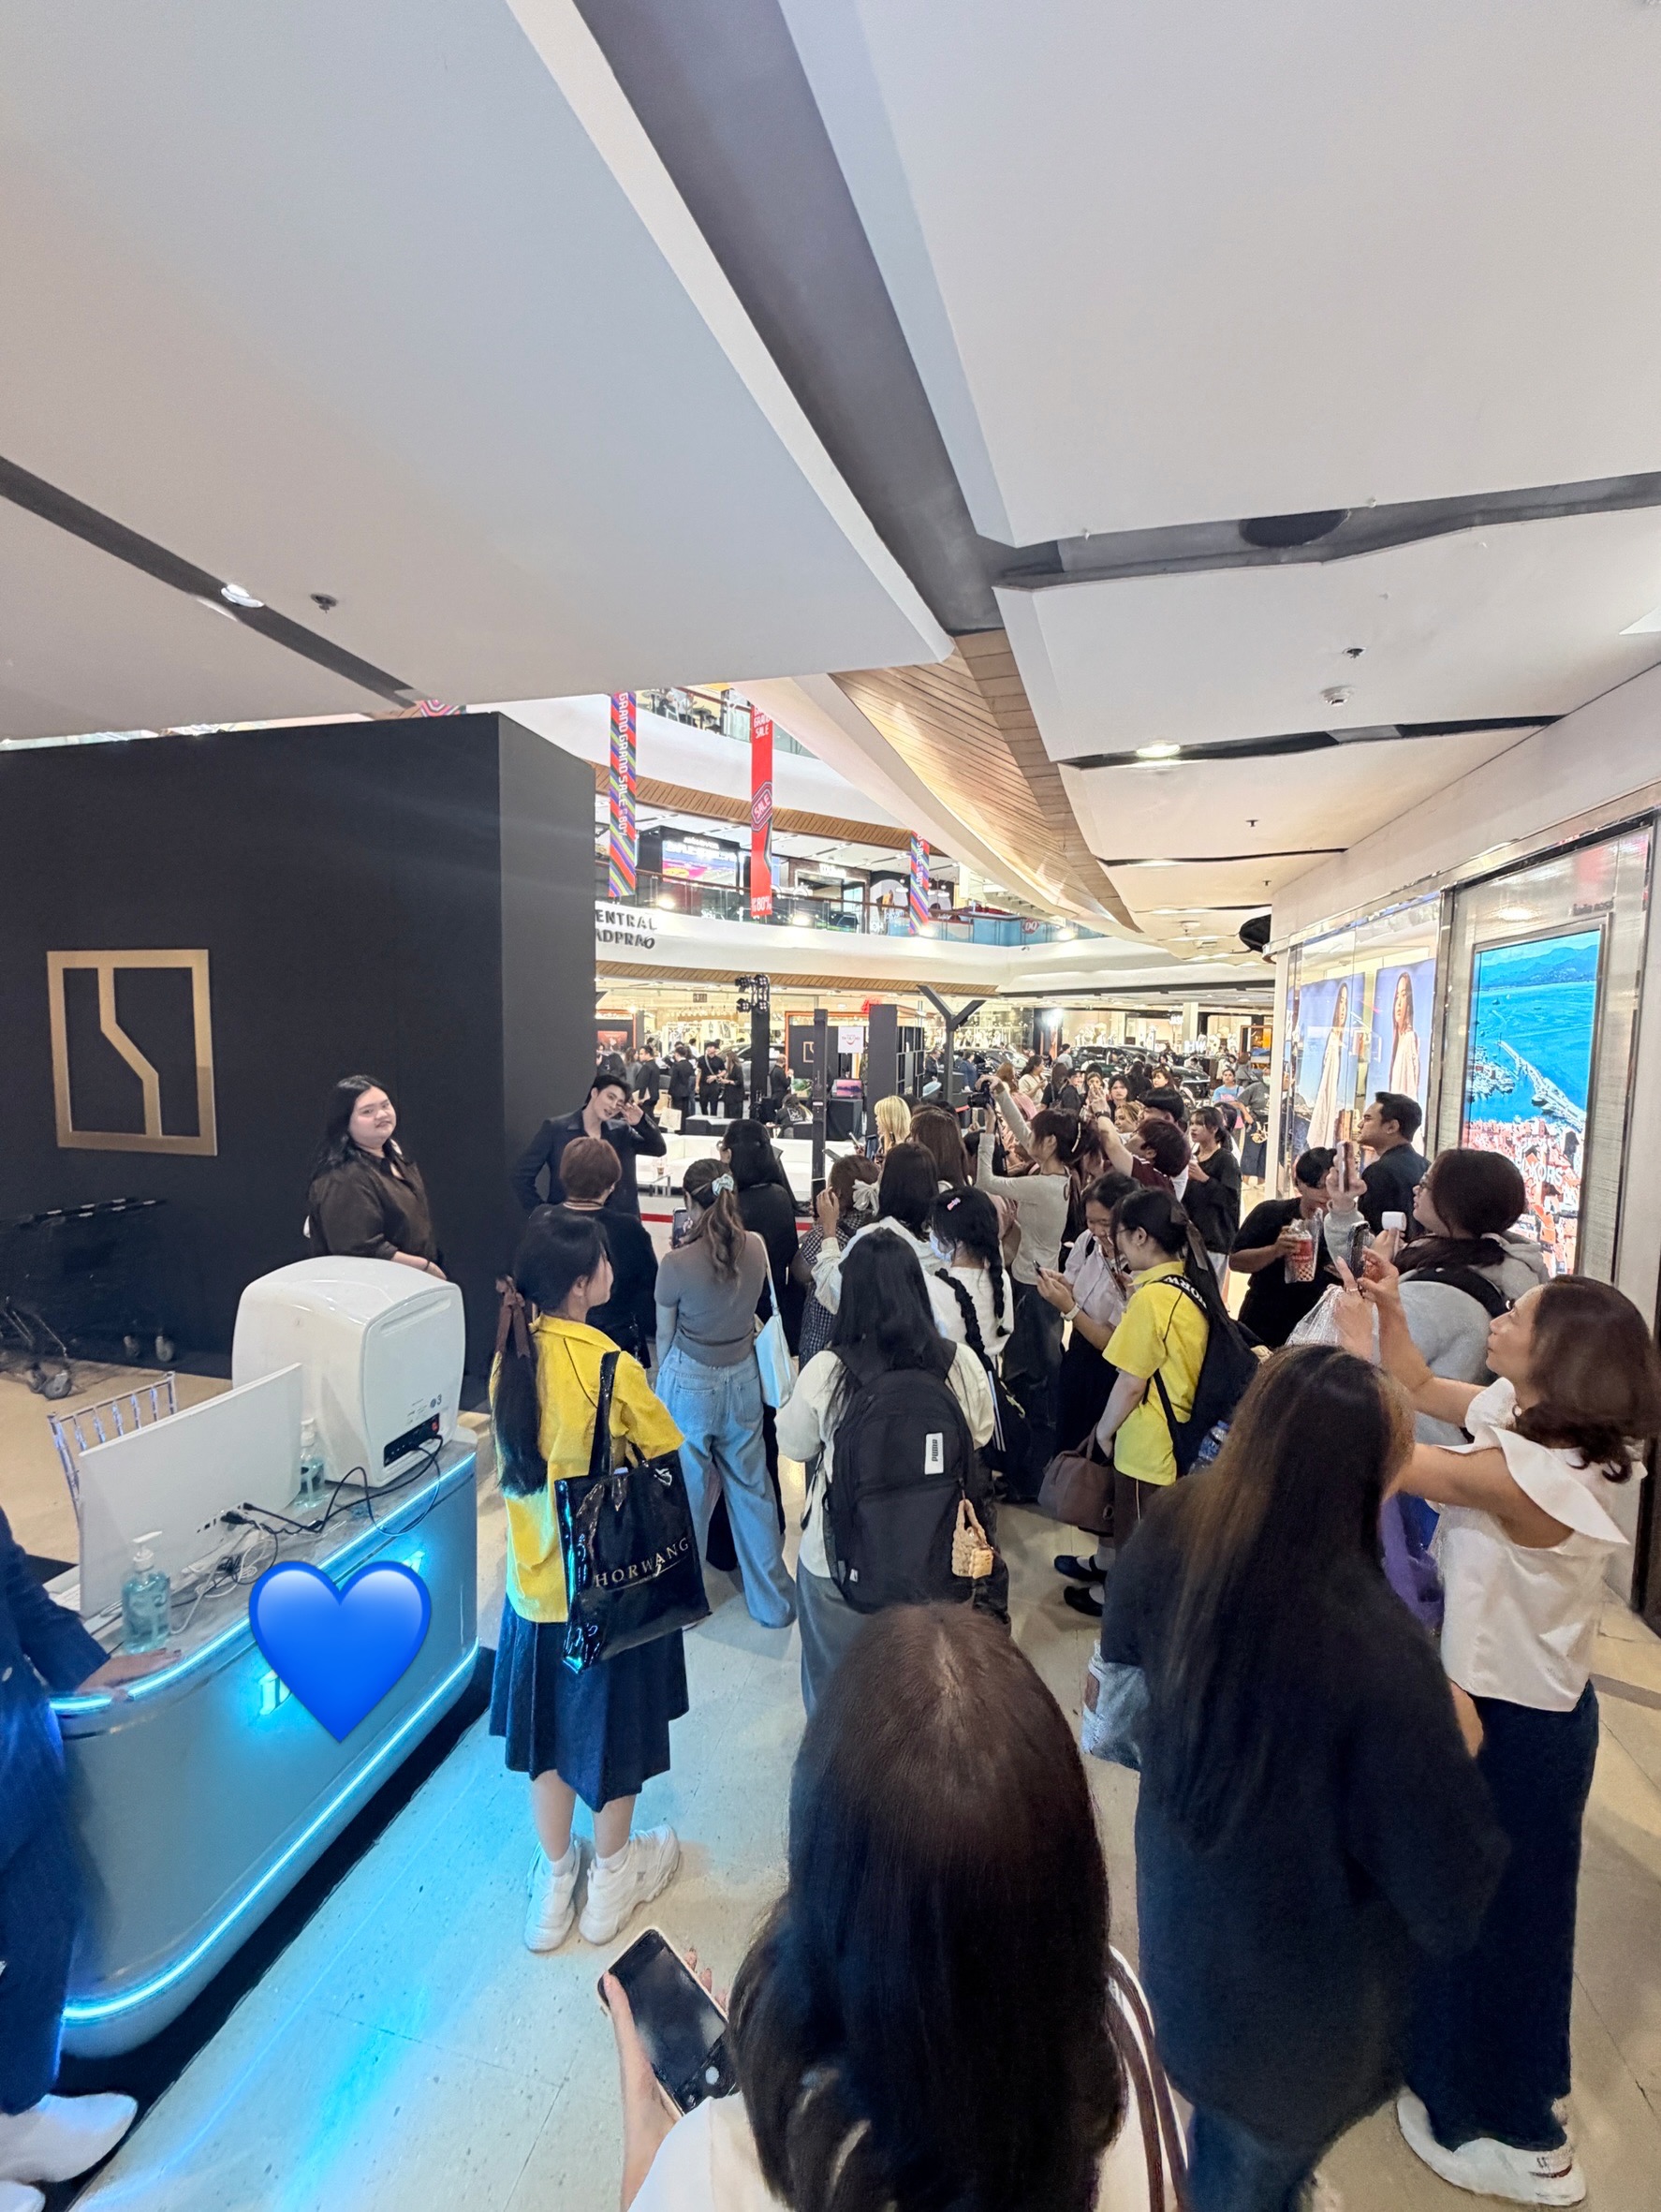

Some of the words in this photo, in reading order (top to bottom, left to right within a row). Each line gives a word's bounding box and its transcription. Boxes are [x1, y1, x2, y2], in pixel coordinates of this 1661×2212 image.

[618, 692, 629, 733] GRAND
[755, 724, 770, 739] SALE
[618, 733, 629, 774] GRAND
[618, 776, 629, 807] SALE
[754, 793, 772, 819] SALE
[595, 909, 657, 930] ENTRAL
[595, 1537, 689, 1587] HORWANG
